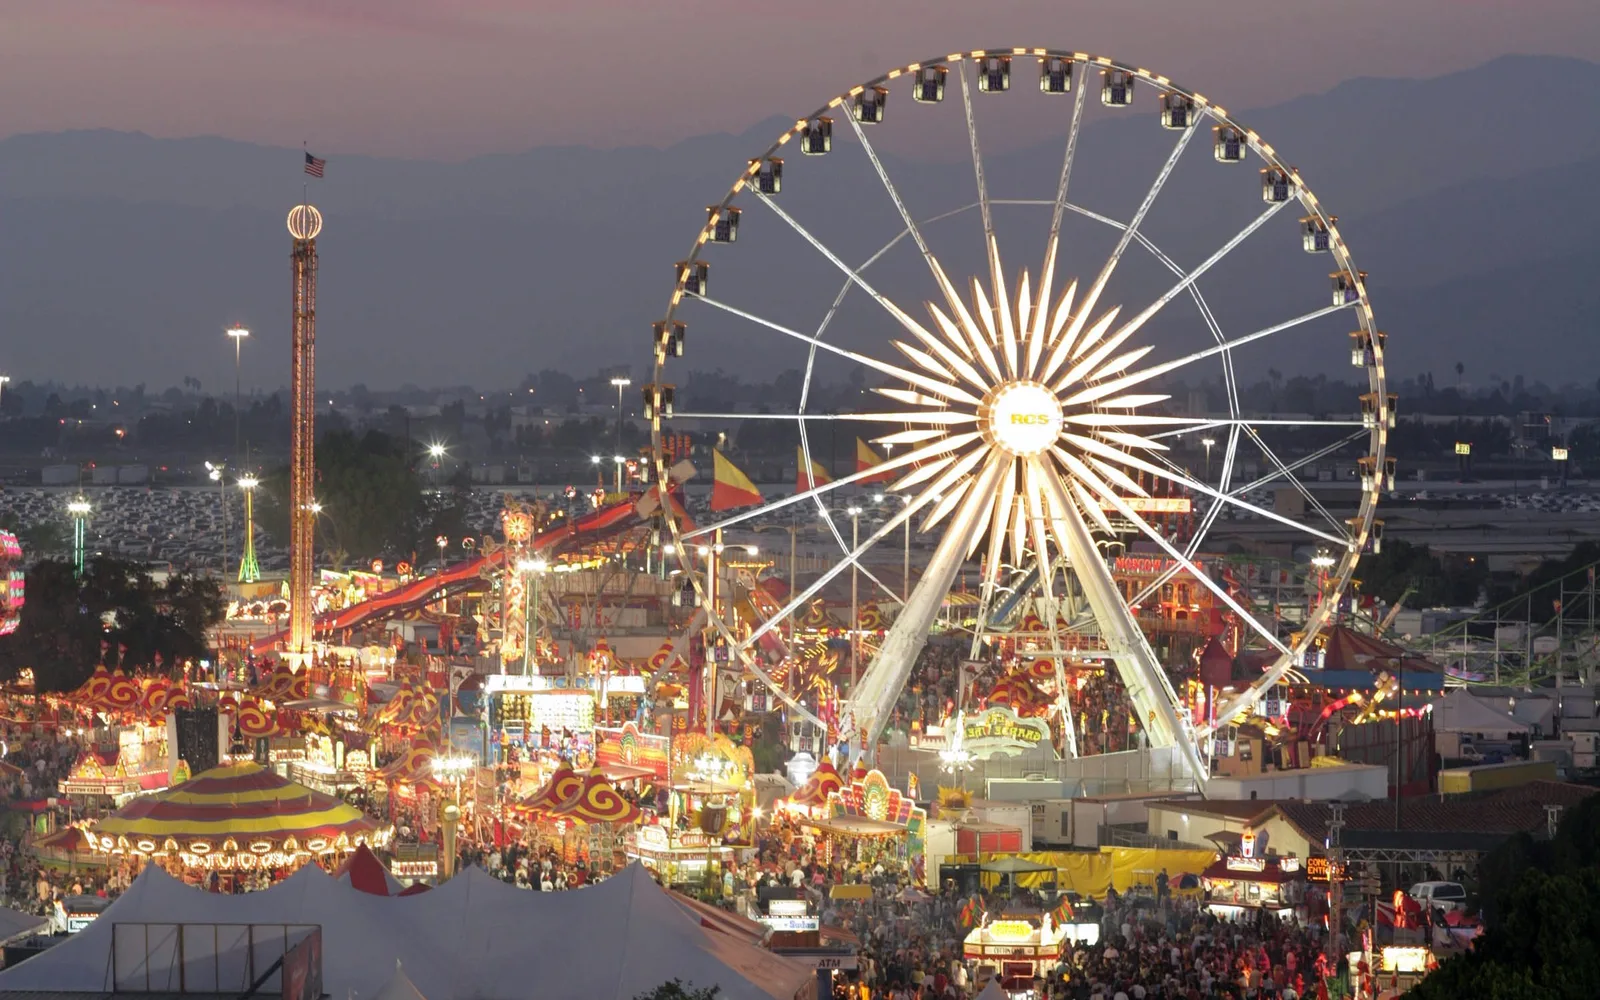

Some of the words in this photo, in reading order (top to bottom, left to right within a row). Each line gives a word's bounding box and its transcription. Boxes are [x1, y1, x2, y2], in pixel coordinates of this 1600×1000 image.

[1011, 413, 1048, 424] RCS
[1032, 804, 1045, 814] CAT
[818, 958, 840, 968] ATM
